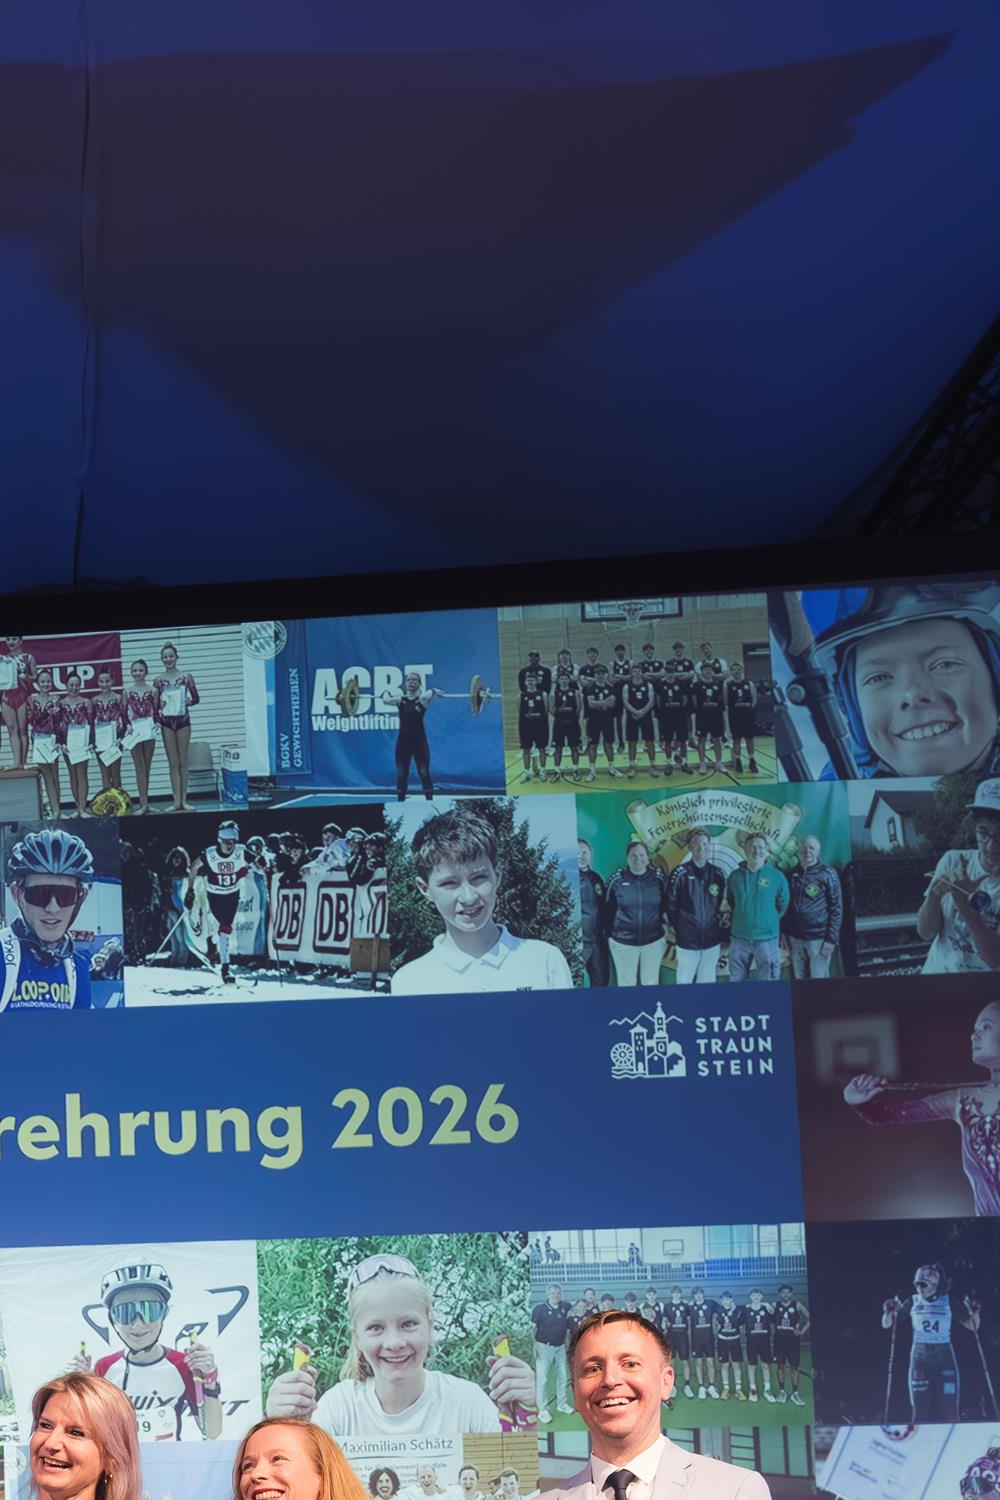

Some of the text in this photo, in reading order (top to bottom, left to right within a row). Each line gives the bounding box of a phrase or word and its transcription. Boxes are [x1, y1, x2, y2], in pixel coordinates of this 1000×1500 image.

[288, 668, 301, 767] GEWICHTHEBEN
[311, 714, 400, 731] Weightliftin
[656, 795, 773, 820] Königlich privilegierte
[217, 874, 237, 887] 131
[276, 894, 302, 940] DB
[317, 892, 350, 943] DB
[695, 1014, 771, 1034] STADT
[696, 1036, 773, 1055] TRAUN
[698, 1058, 774, 1077] STEIN
[331, 1083, 520, 1149] 2026
[922, 1320, 940, 1333] 24
[341, 1437, 454, 1454] Maximilian Schätz
